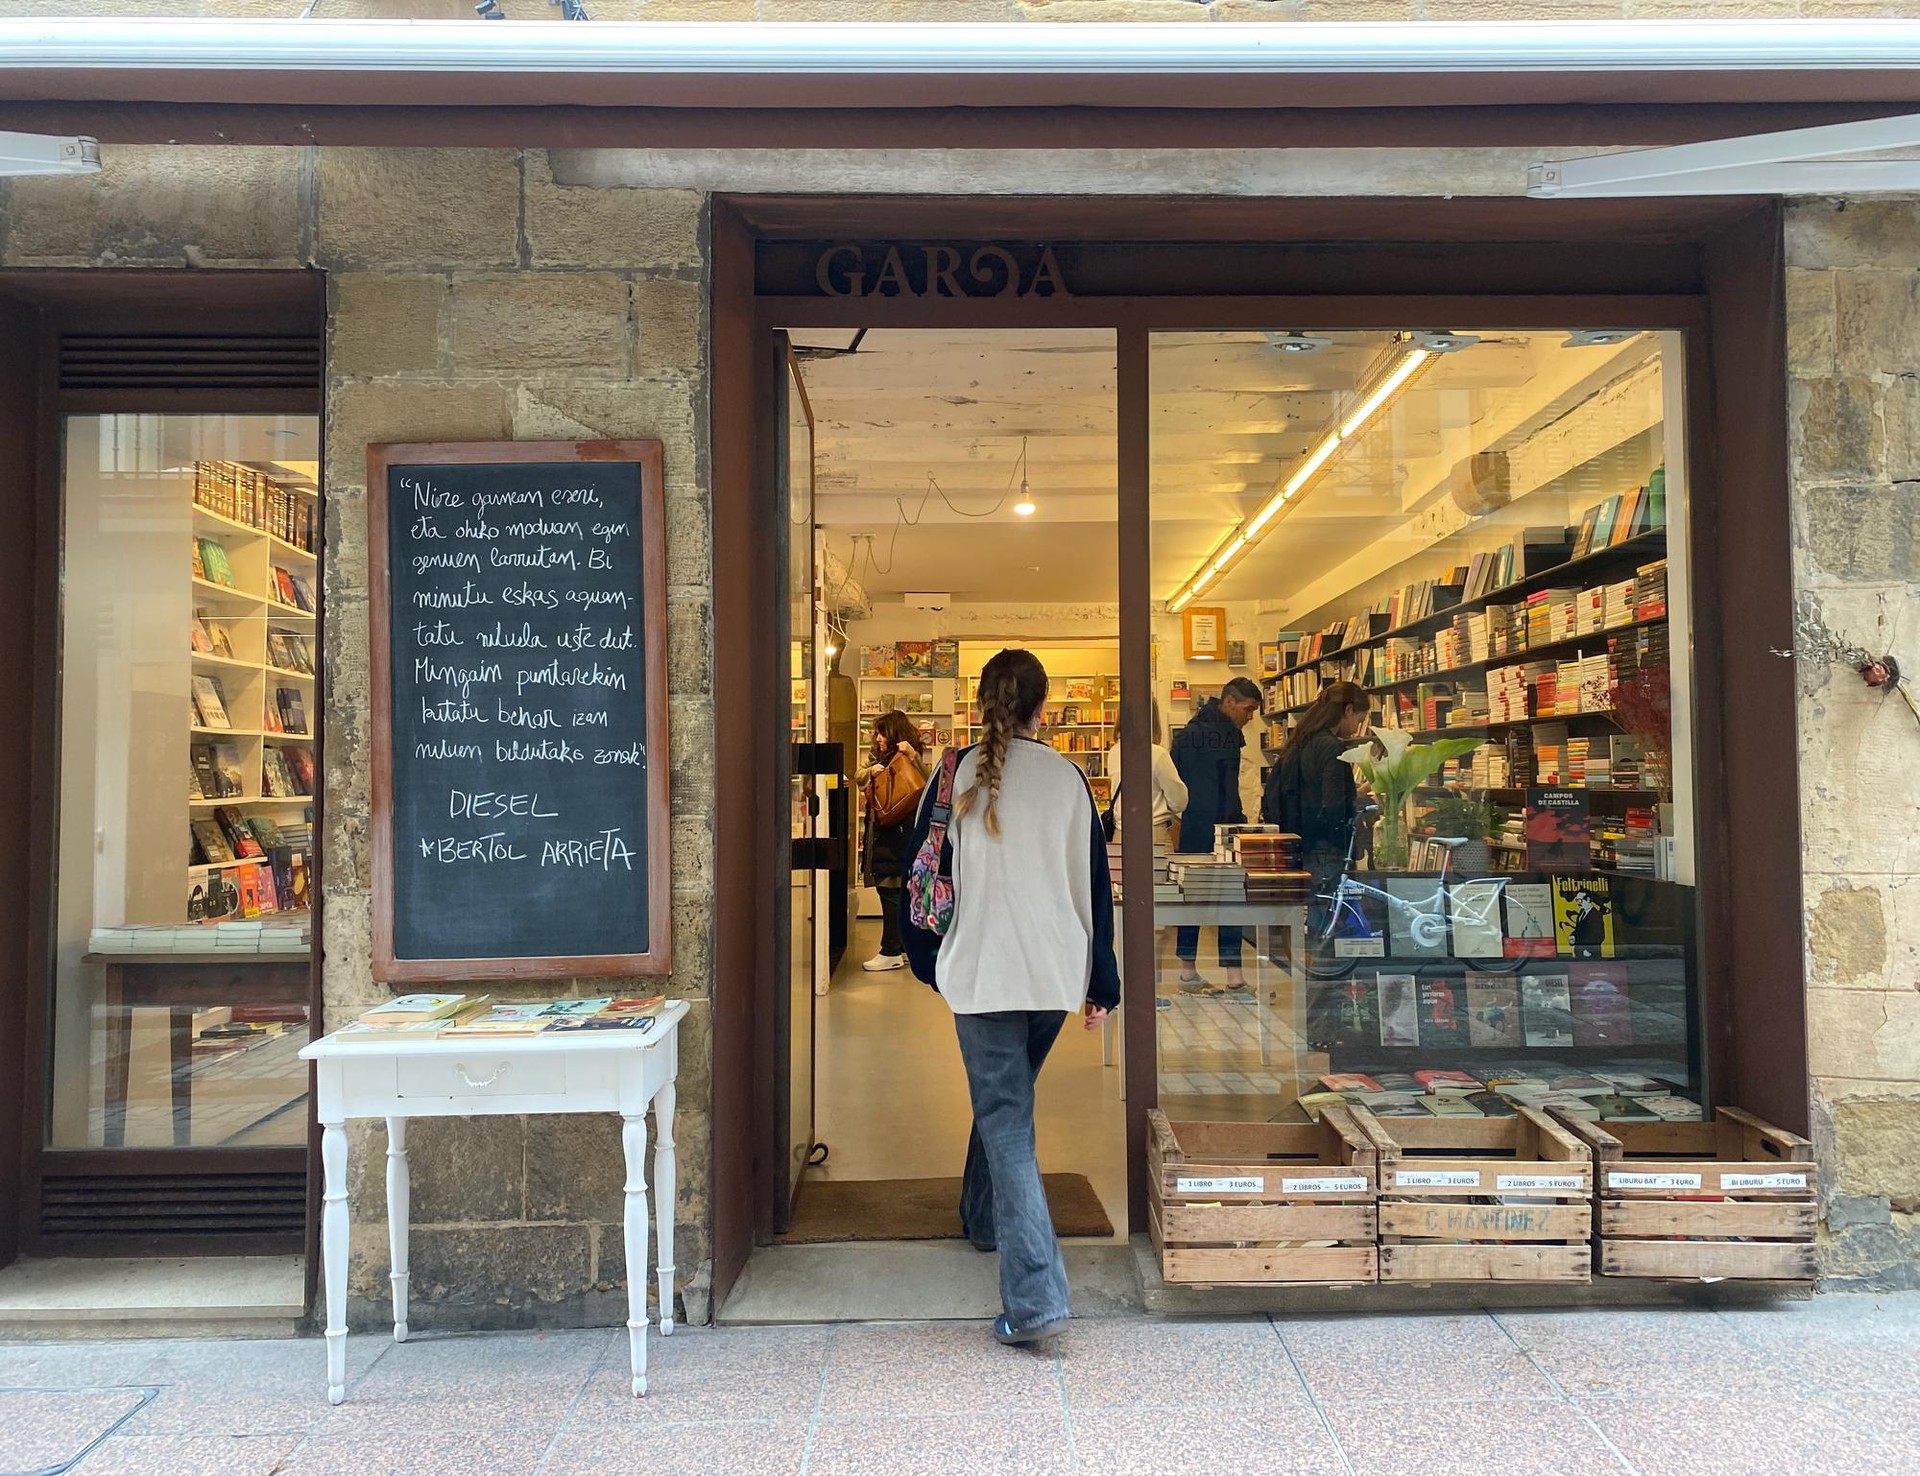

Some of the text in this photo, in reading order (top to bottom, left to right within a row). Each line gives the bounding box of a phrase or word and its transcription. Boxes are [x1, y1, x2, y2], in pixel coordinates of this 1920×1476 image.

[411, 516, 447, 539] eta
[506, 518, 583, 540] moduan
[413, 556, 481, 575] genuen
[588, 547, 612, 569] Bi
[413, 581, 494, 609] minutu
[502, 581, 559, 609] eskas
[412, 620, 464, 646] tatu
[557, 623, 596, 651] uste
[599, 625, 637, 650] dut.
[415, 656, 626, 699] Mingain puntarekin
[498, 697, 562, 729] behar
[572, 708, 608, 727] izan
[450, 789, 559, 819] DIESEL
[541, 828, 636, 871] ARRIETA
[1556, 876, 1609, 892] Feltrinelli
[1447, 1208, 1551, 1232] MARTINEZ
